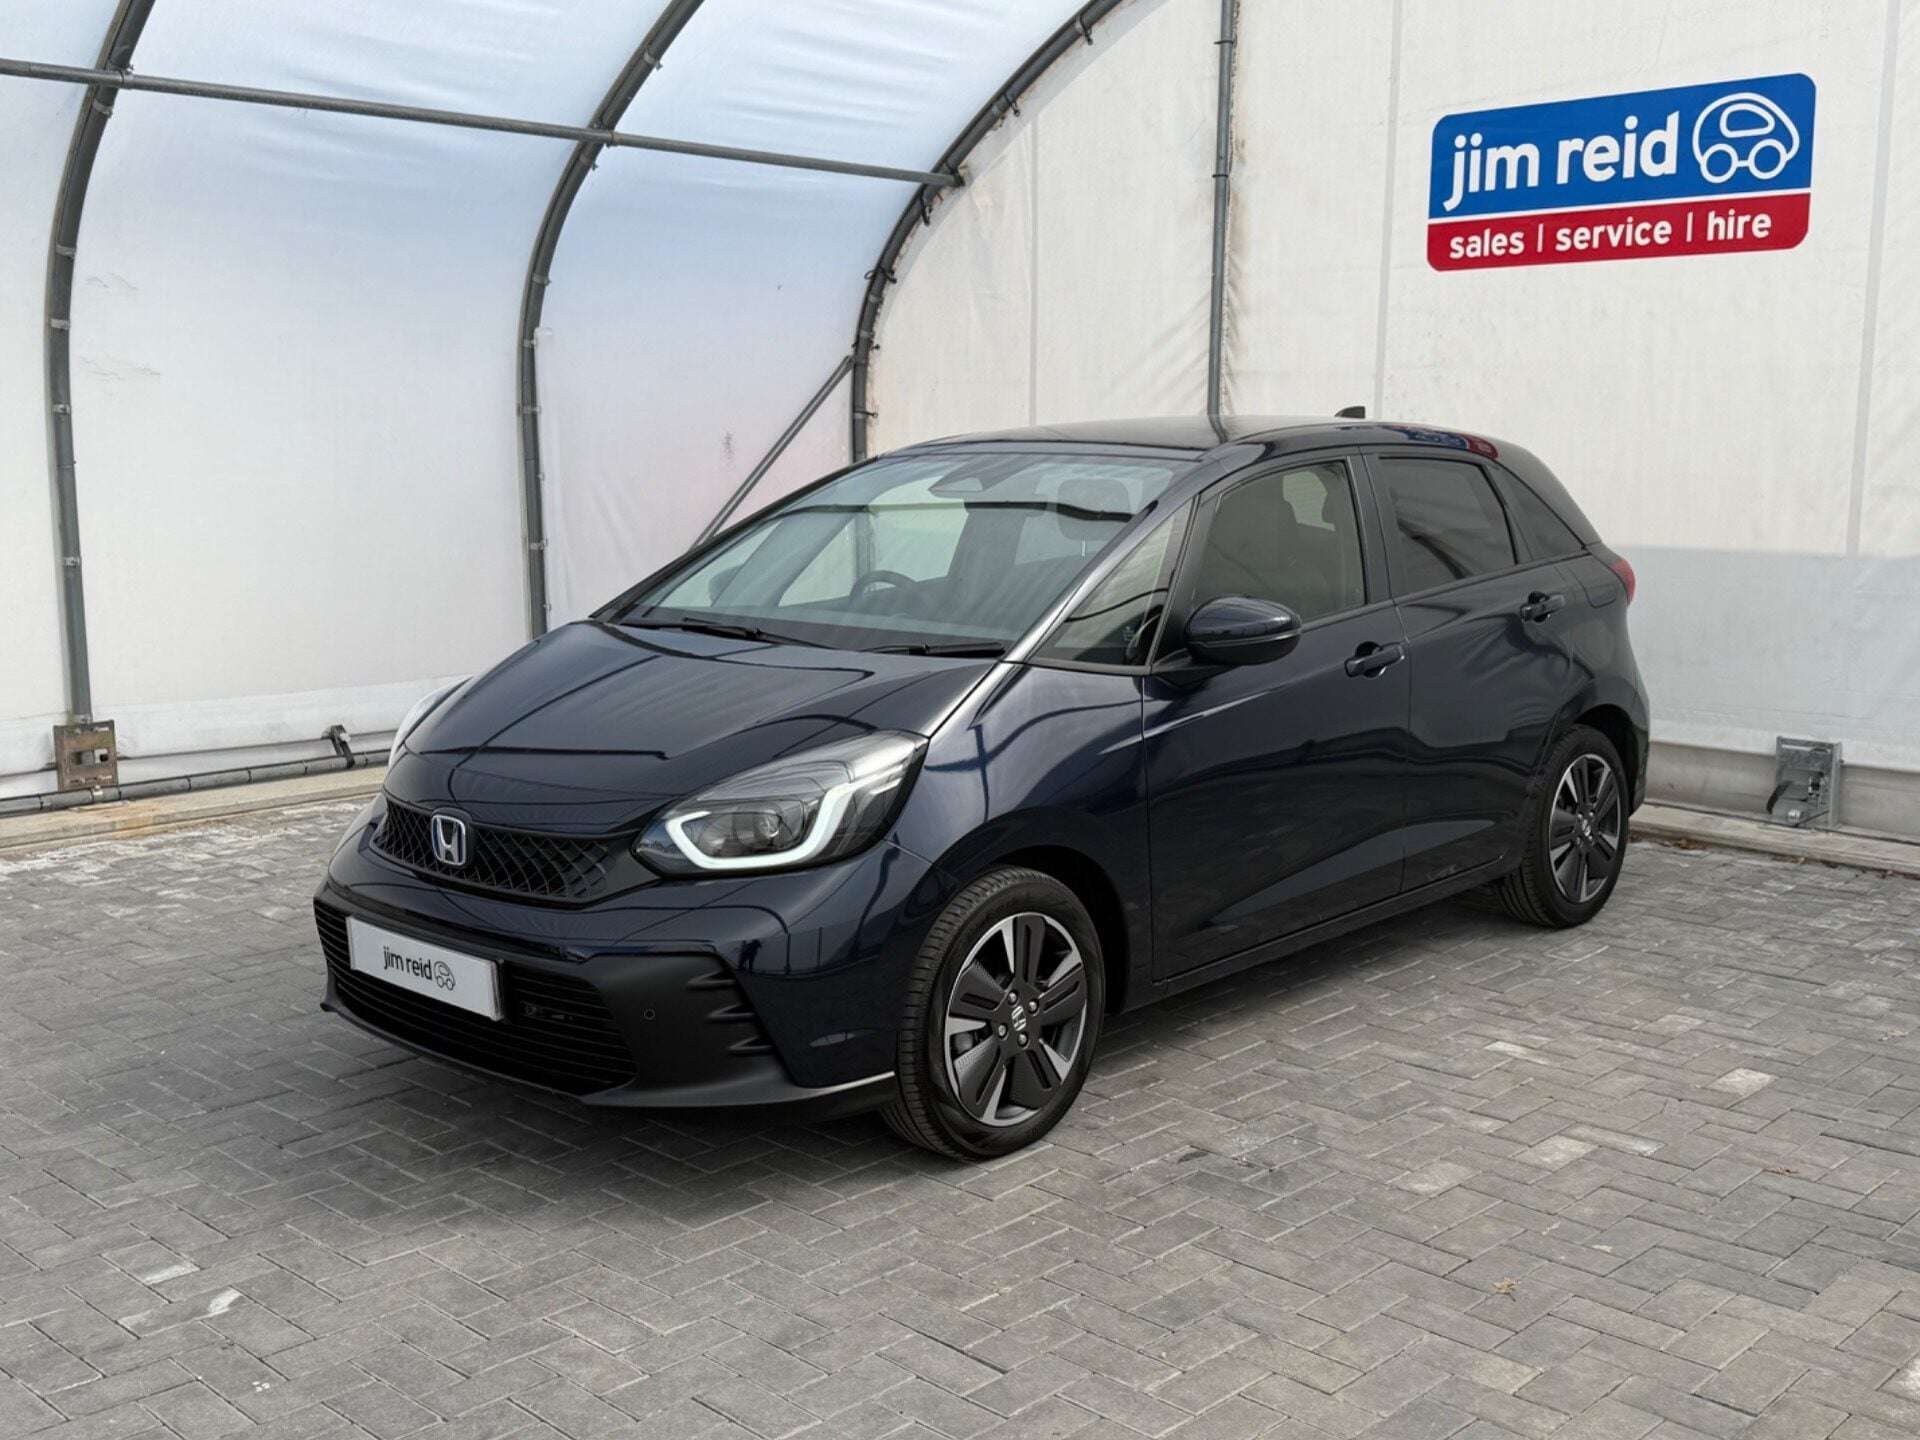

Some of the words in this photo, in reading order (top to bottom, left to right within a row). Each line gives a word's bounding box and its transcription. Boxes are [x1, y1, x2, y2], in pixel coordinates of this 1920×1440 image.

[1443, 132, 1540, 212] jim
[1556, 110, 1680, 185] reid
[1449, 229, 1525, 259] sales
[1555, 216, 1673, 251] service
[1707, 208, 1771, 241] hire
[383, 946, 404, 970] jim
[405, 955, 433, 980] reid
